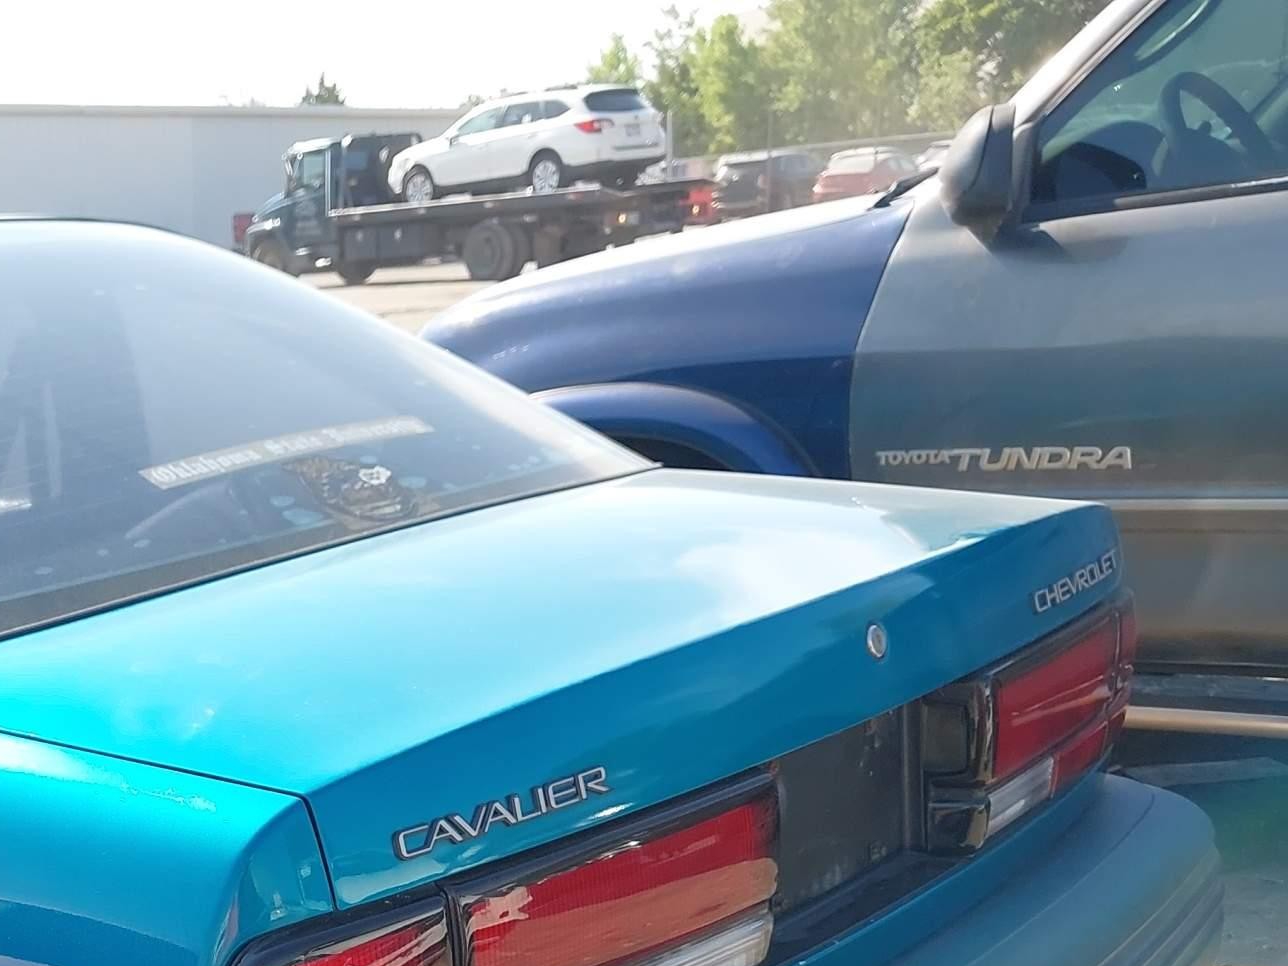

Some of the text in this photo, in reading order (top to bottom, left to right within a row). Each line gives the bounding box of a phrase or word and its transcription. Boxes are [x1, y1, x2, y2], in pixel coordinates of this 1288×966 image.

[876, 446, 1132, 471] TOYOTA TUNDRA
[1034, 549, 1117, 613] CHEVROLET
[394, 766, 610, 859] CAVALIER
